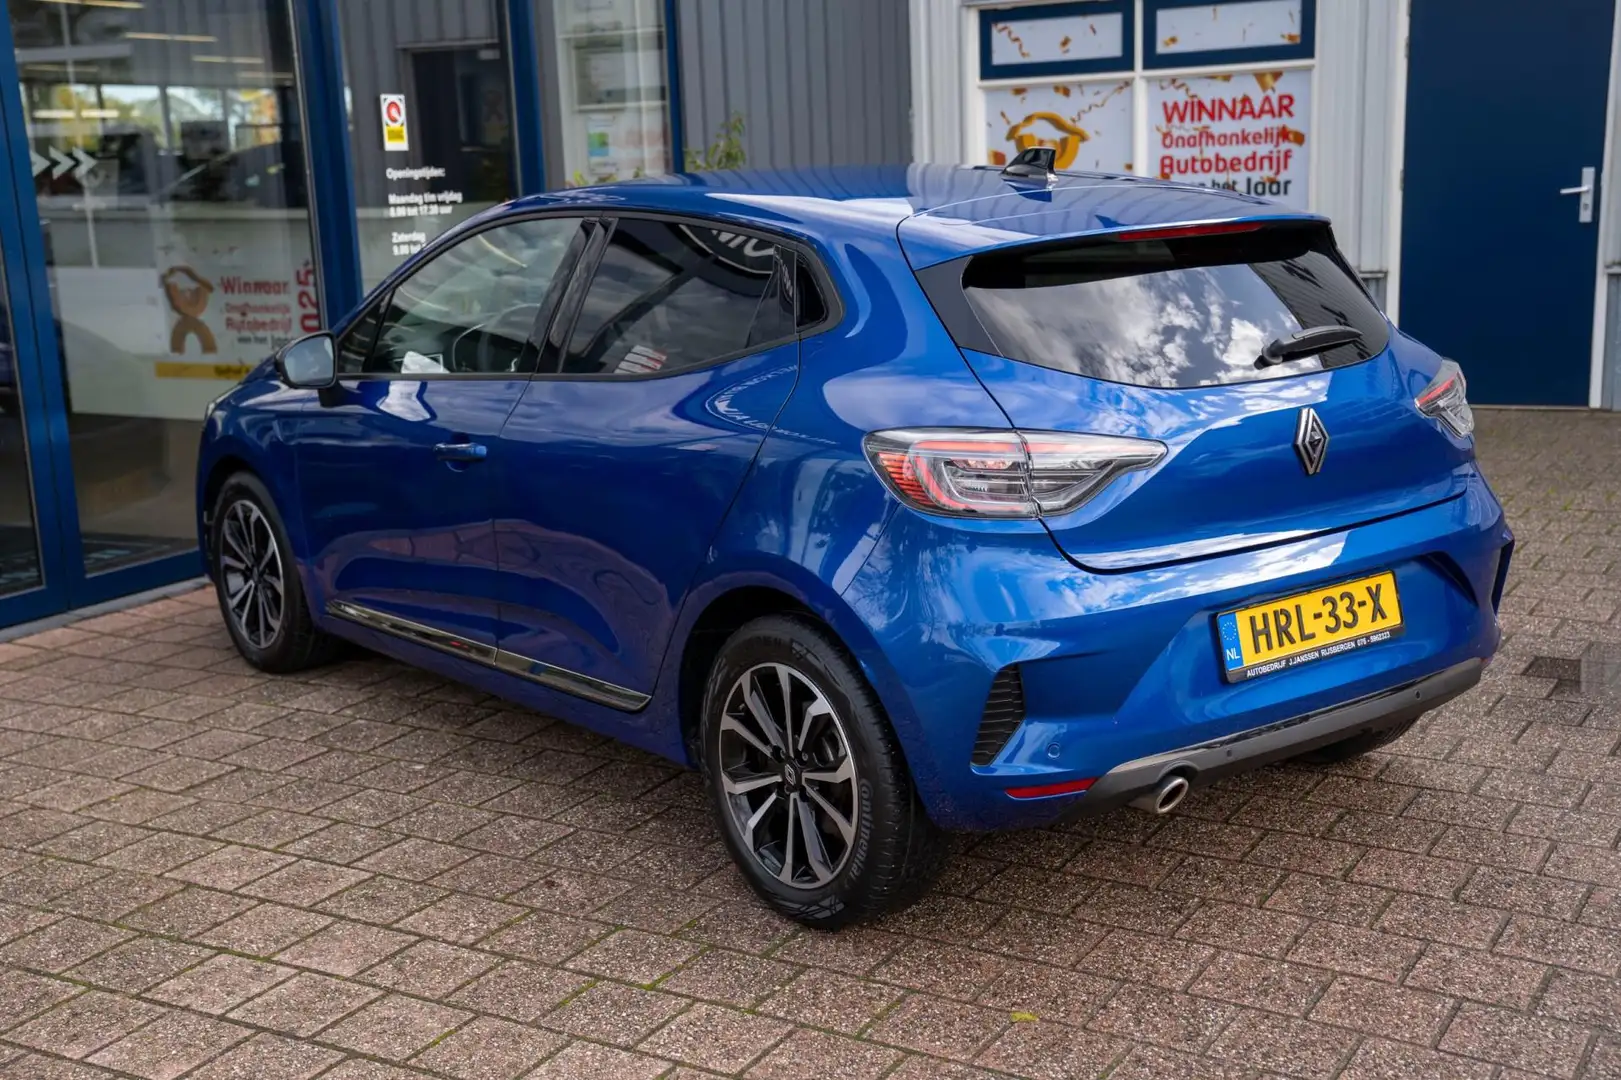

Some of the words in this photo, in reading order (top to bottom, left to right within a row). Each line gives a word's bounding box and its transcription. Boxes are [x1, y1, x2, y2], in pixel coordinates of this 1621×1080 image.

[1162, 93, 1295, 124] WINNAAR
[1161, 126, 1292, 149] Onafhankelijk
[1160, 148, 1293, 176] Autobedrijf
[1249, 583, 1388, 654] HRL-33-X
[1226, 647, 1241, 661] NL
[1246, 660, 1286, 678] AUTOBEDRIJF
[1289, 651, 1319, 666] J.JANSSEN
[1321, 641, 1356, 657] RIJSBERGEN
